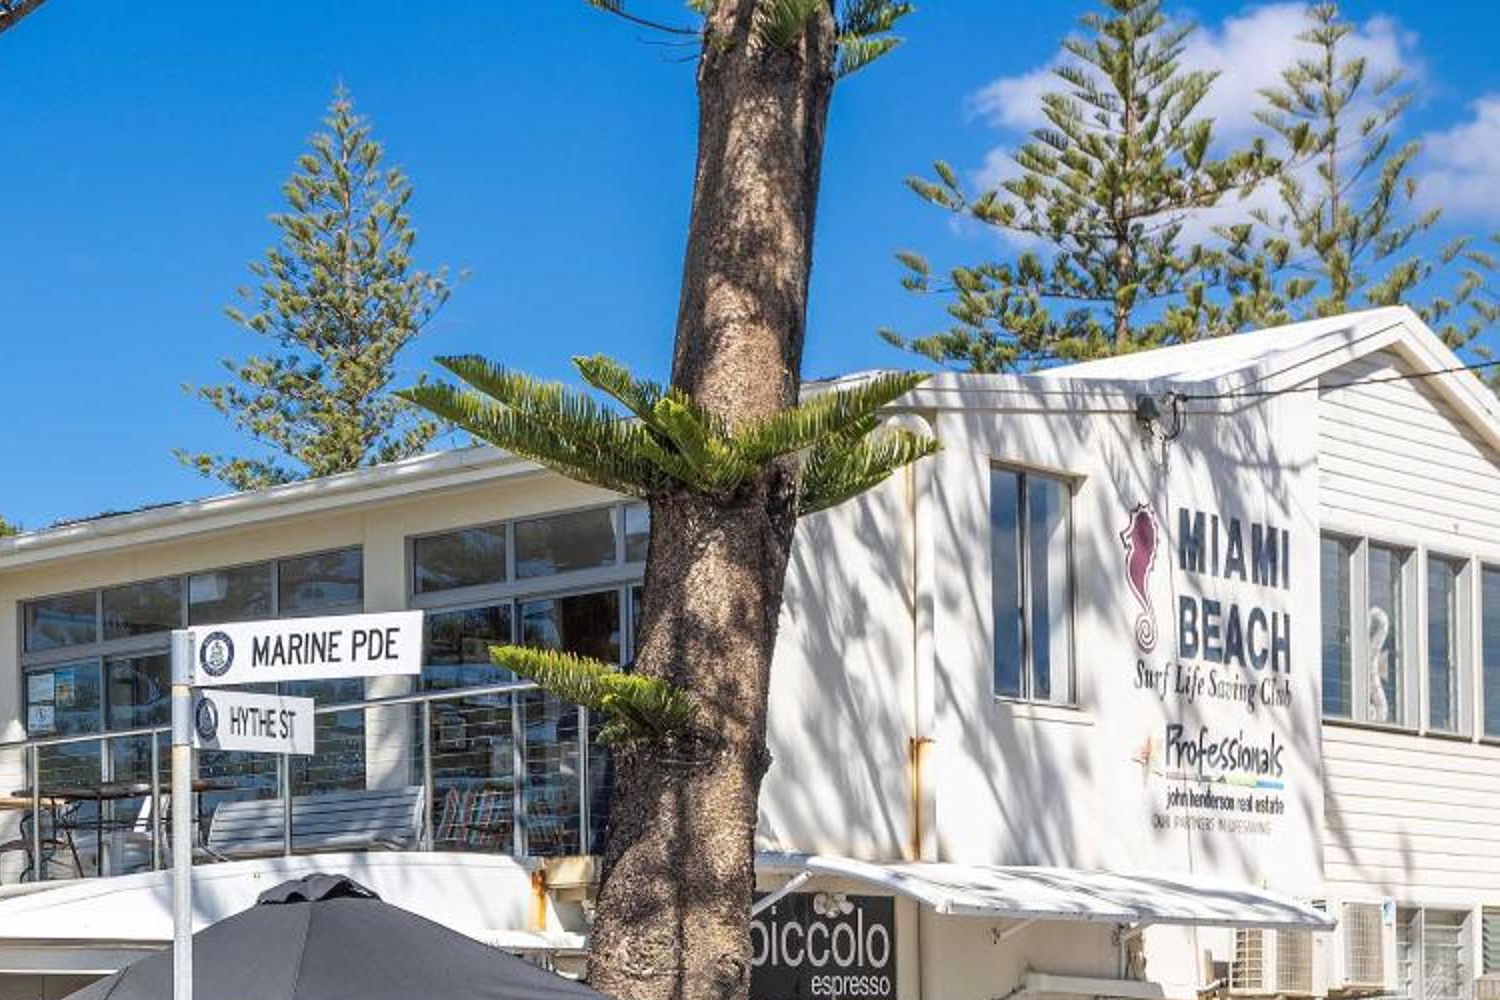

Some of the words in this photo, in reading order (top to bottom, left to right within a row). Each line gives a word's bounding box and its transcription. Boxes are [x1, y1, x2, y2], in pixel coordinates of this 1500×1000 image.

[1179, 508, 1290, 589] MIAMI
[251, 630, 342, 667] MARINE
[352, 628, 400, 661] PDE
[1179, 595, 1291, 674] BEACH
[1134, 659, 1169, 700] Surf
[1174, 664, 1204, 704] Life
[1208, 670, 1257, 713] Saving
[1260, 678, 1292, 707] Club
[230, 706, 277, 738] HYTHE
[280, 710, 296, 739] ST
[1166, 724, 1284, 785] Professionals
[1165, 785, 1189, 811] john
[1190, 785, 1235, 812] henderson
[1255, 796, 1285, 815] estate
[811, 974, 891, 1000] espresso
